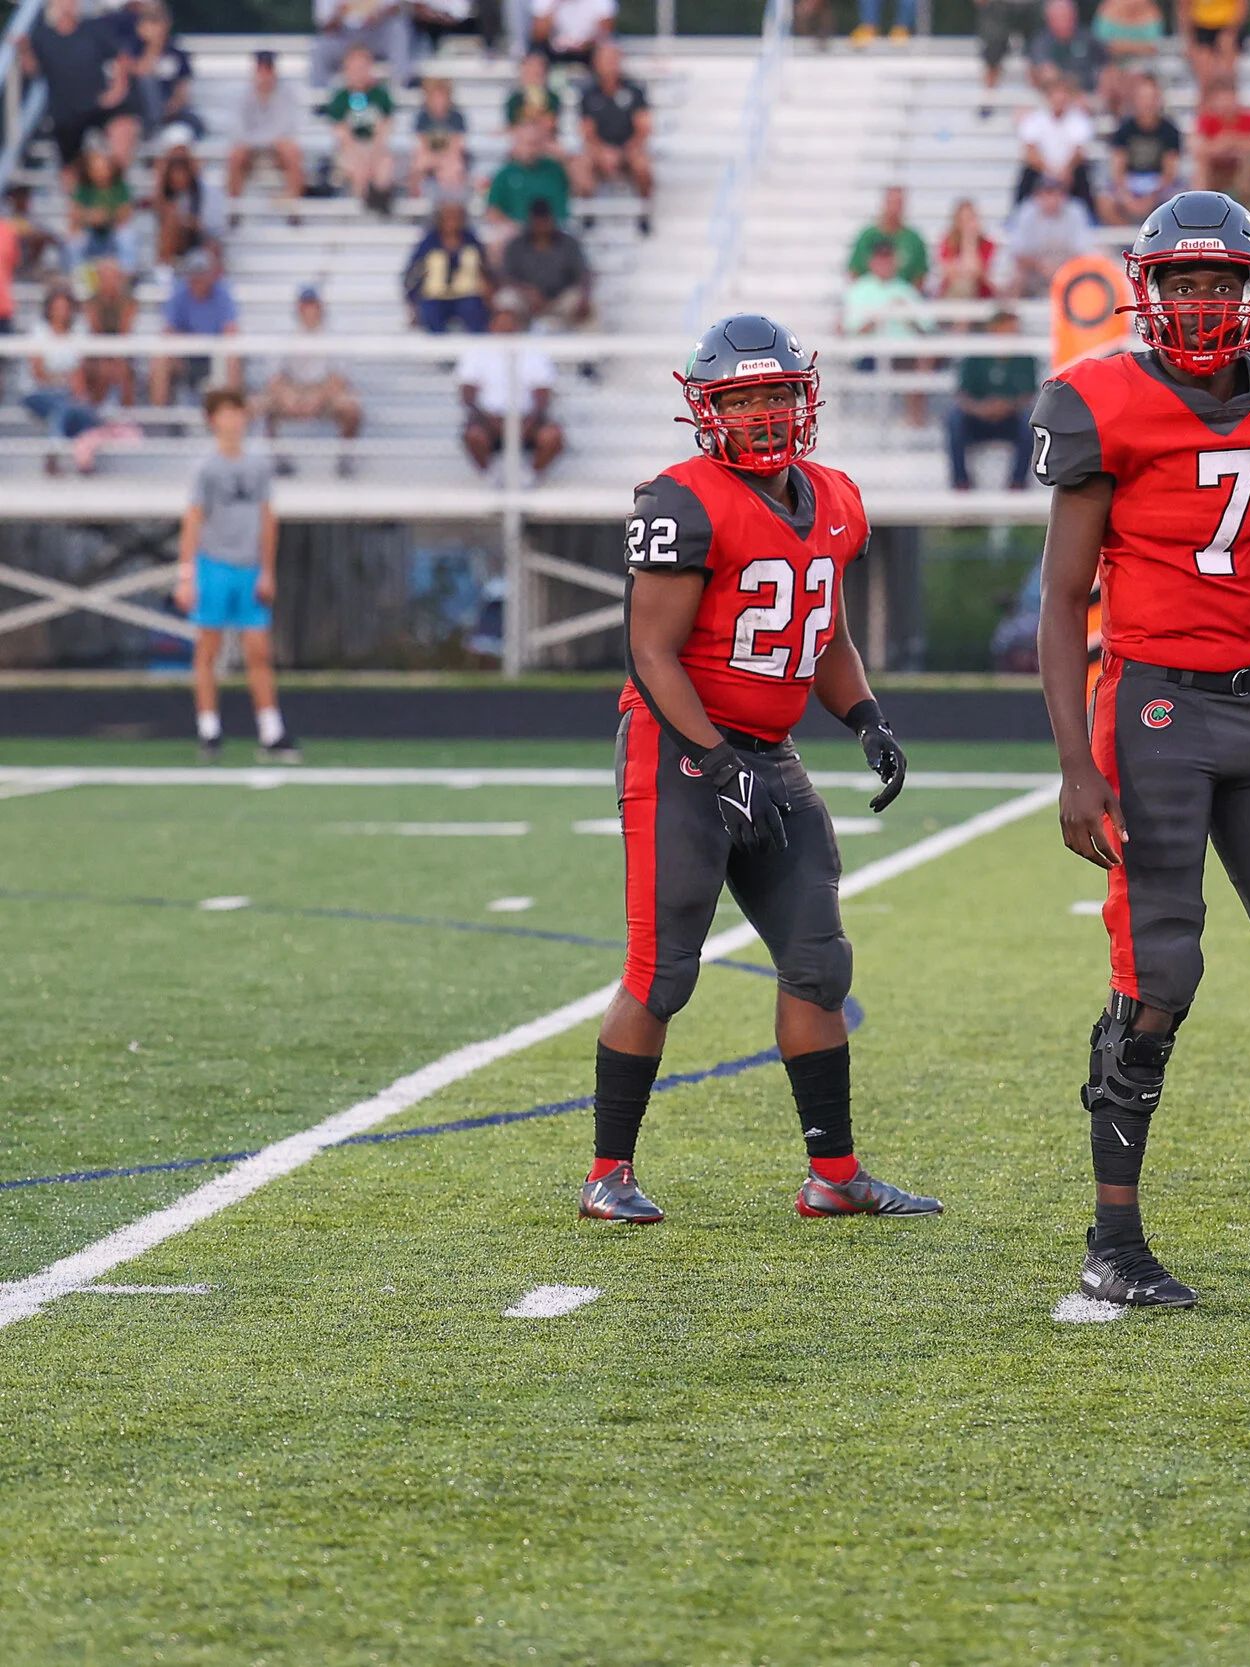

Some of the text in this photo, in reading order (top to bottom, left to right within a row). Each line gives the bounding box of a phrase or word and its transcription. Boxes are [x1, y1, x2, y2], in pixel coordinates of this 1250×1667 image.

[1181, 240, 1220, 249] Riddell
[741, 361, 777, 371] Riddell
[1033, 426, 1052, 475] 7
[626, 516, 678, 563] 22
[728, 556, 836, 680] 22
